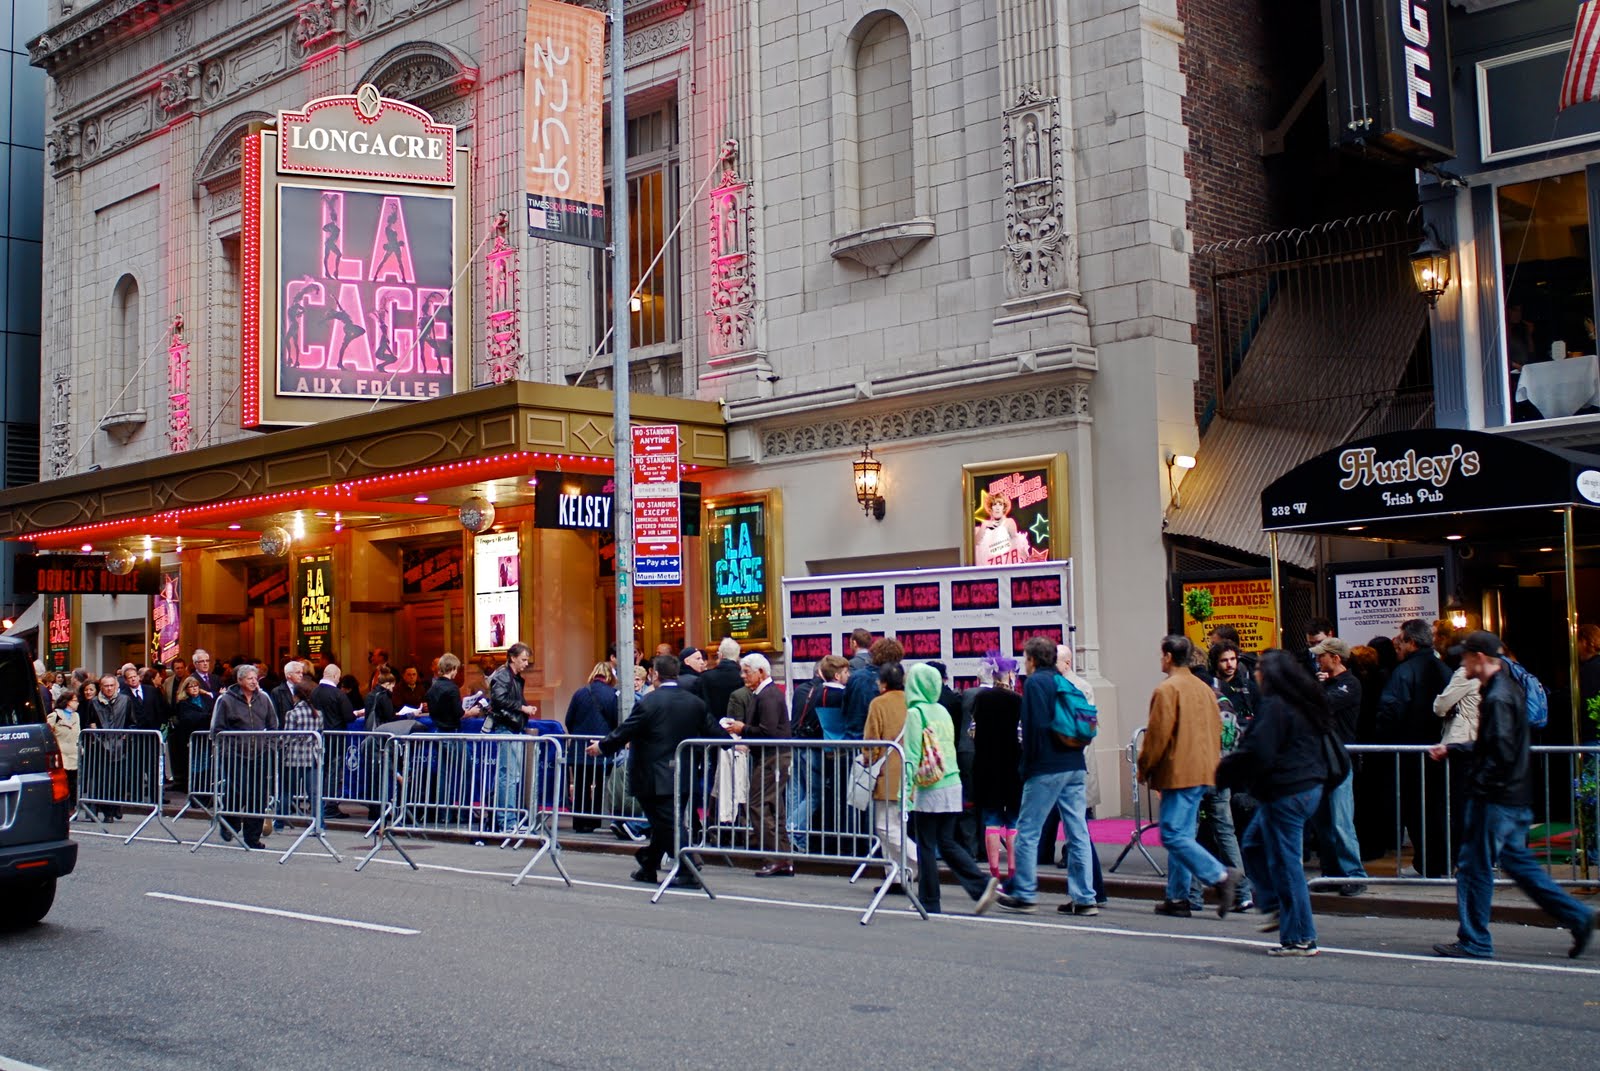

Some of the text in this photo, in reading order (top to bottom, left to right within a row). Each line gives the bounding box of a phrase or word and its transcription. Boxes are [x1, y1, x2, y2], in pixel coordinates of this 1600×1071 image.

[531, 36, 570, 192] ようこそ
[589, 24, 602, 197] CROSSROADS OF THE WORLD
[291, 126, 443, 160] LONGACRE
[322, 191, 416, 284] LA
[286, 279, 450, 375] CAGE
[296, 377, 441, 397] AUX FOLLES
[1339, 443, 1480, 490] Hurley's
[1382, 488, 1444, 507] Irish Pub
[559, 494, 610, 528] KELSEY
[1272, 502, 1307, 516] 232 W
[724, 523, 752, 559] LA
[646, 559, 659, 567] Pay
[37, 569, 94, 591] DOUGLAS
[307, 569, 324, 597] LA
[716, 557, 762, 595] CAGE
[1377, 575, 1436, 586] FUNNIEST
[897, 588, 911, 607] LA
[953, 585, 970, 604] LA
[1012, 582, 1030, 601] LA
[1219, 582, 1270, 594] MUSICAL
[1338, 586, 1430, 599] HEARTBREAKER
[54, 597, 66, 620] LA
[302, 595, 330, 625] CAGE
[791, 594, 805, 612] LA
[843, 591, 857, 610] LA
[1212, 594, 1272, 606] BERANCE!”
[1349, 598, 1401, 609] IN TOWN!
[793, 639, 806, 657] LA
[954, 632, 971, 652] LA
